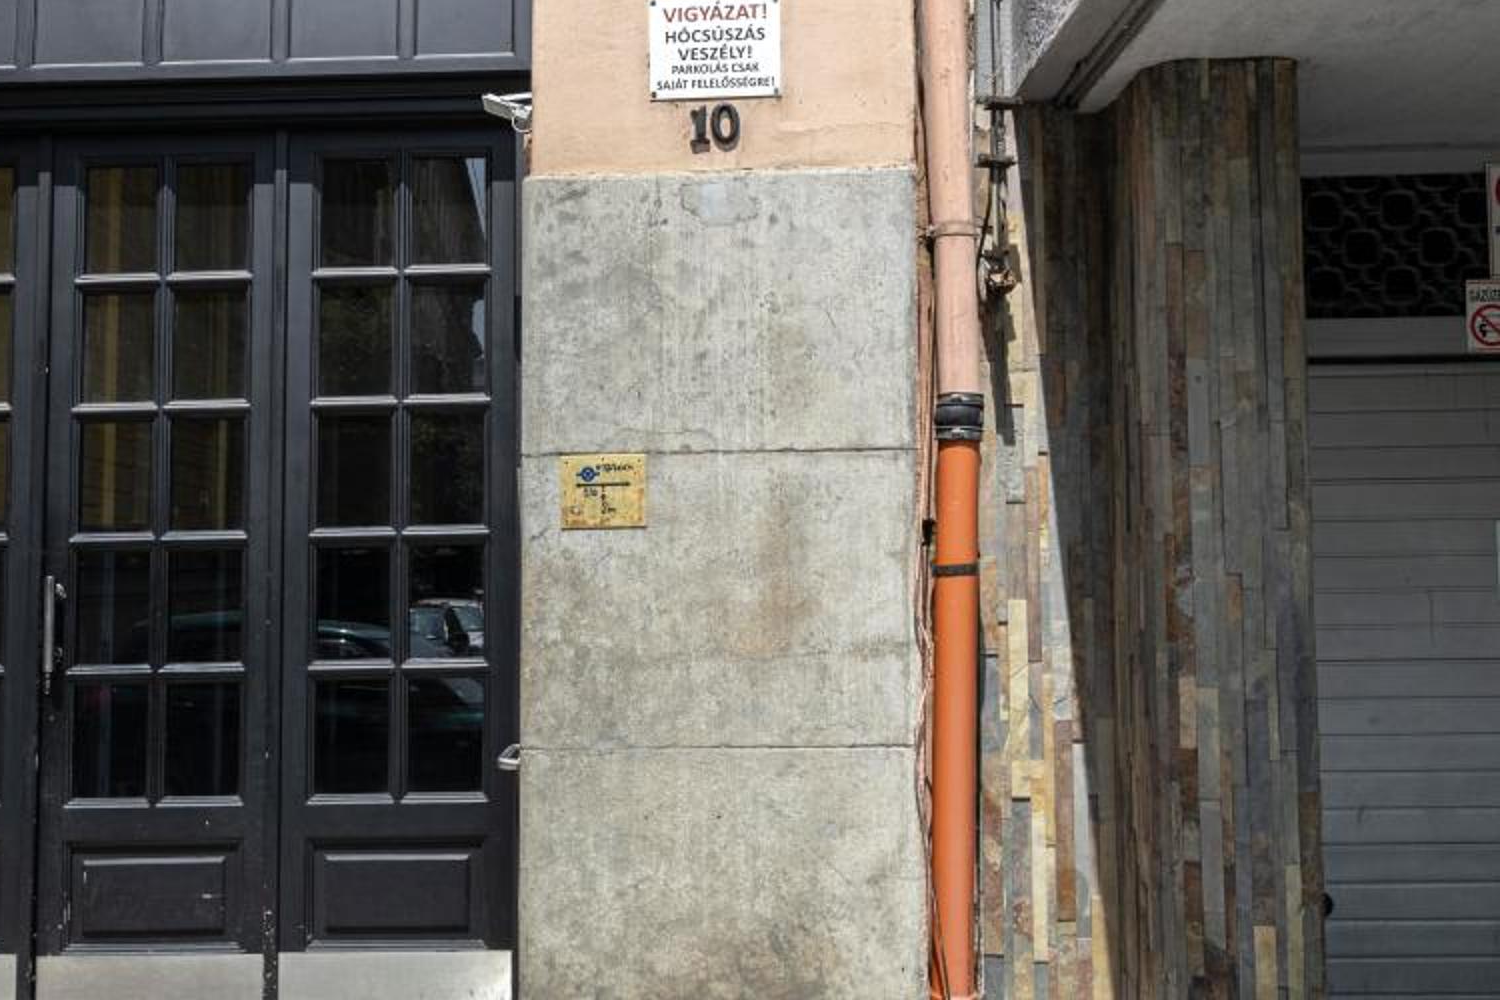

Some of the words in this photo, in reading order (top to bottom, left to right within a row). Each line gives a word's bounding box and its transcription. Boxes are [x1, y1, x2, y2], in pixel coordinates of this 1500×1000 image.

[663, 0, 767, 23] VIGYÁZAT!
[665, 24, 766, 44] HÓCSÚSZÁS
[678, 44, 753, 61] VESZÉLY!
[671, 62, 729, 75] PARKOLÁS
[731, 62, 760, 73] CSAK
[657, 78, 689, 91] SAJÁT
[690, 103, 741, 154] 10
